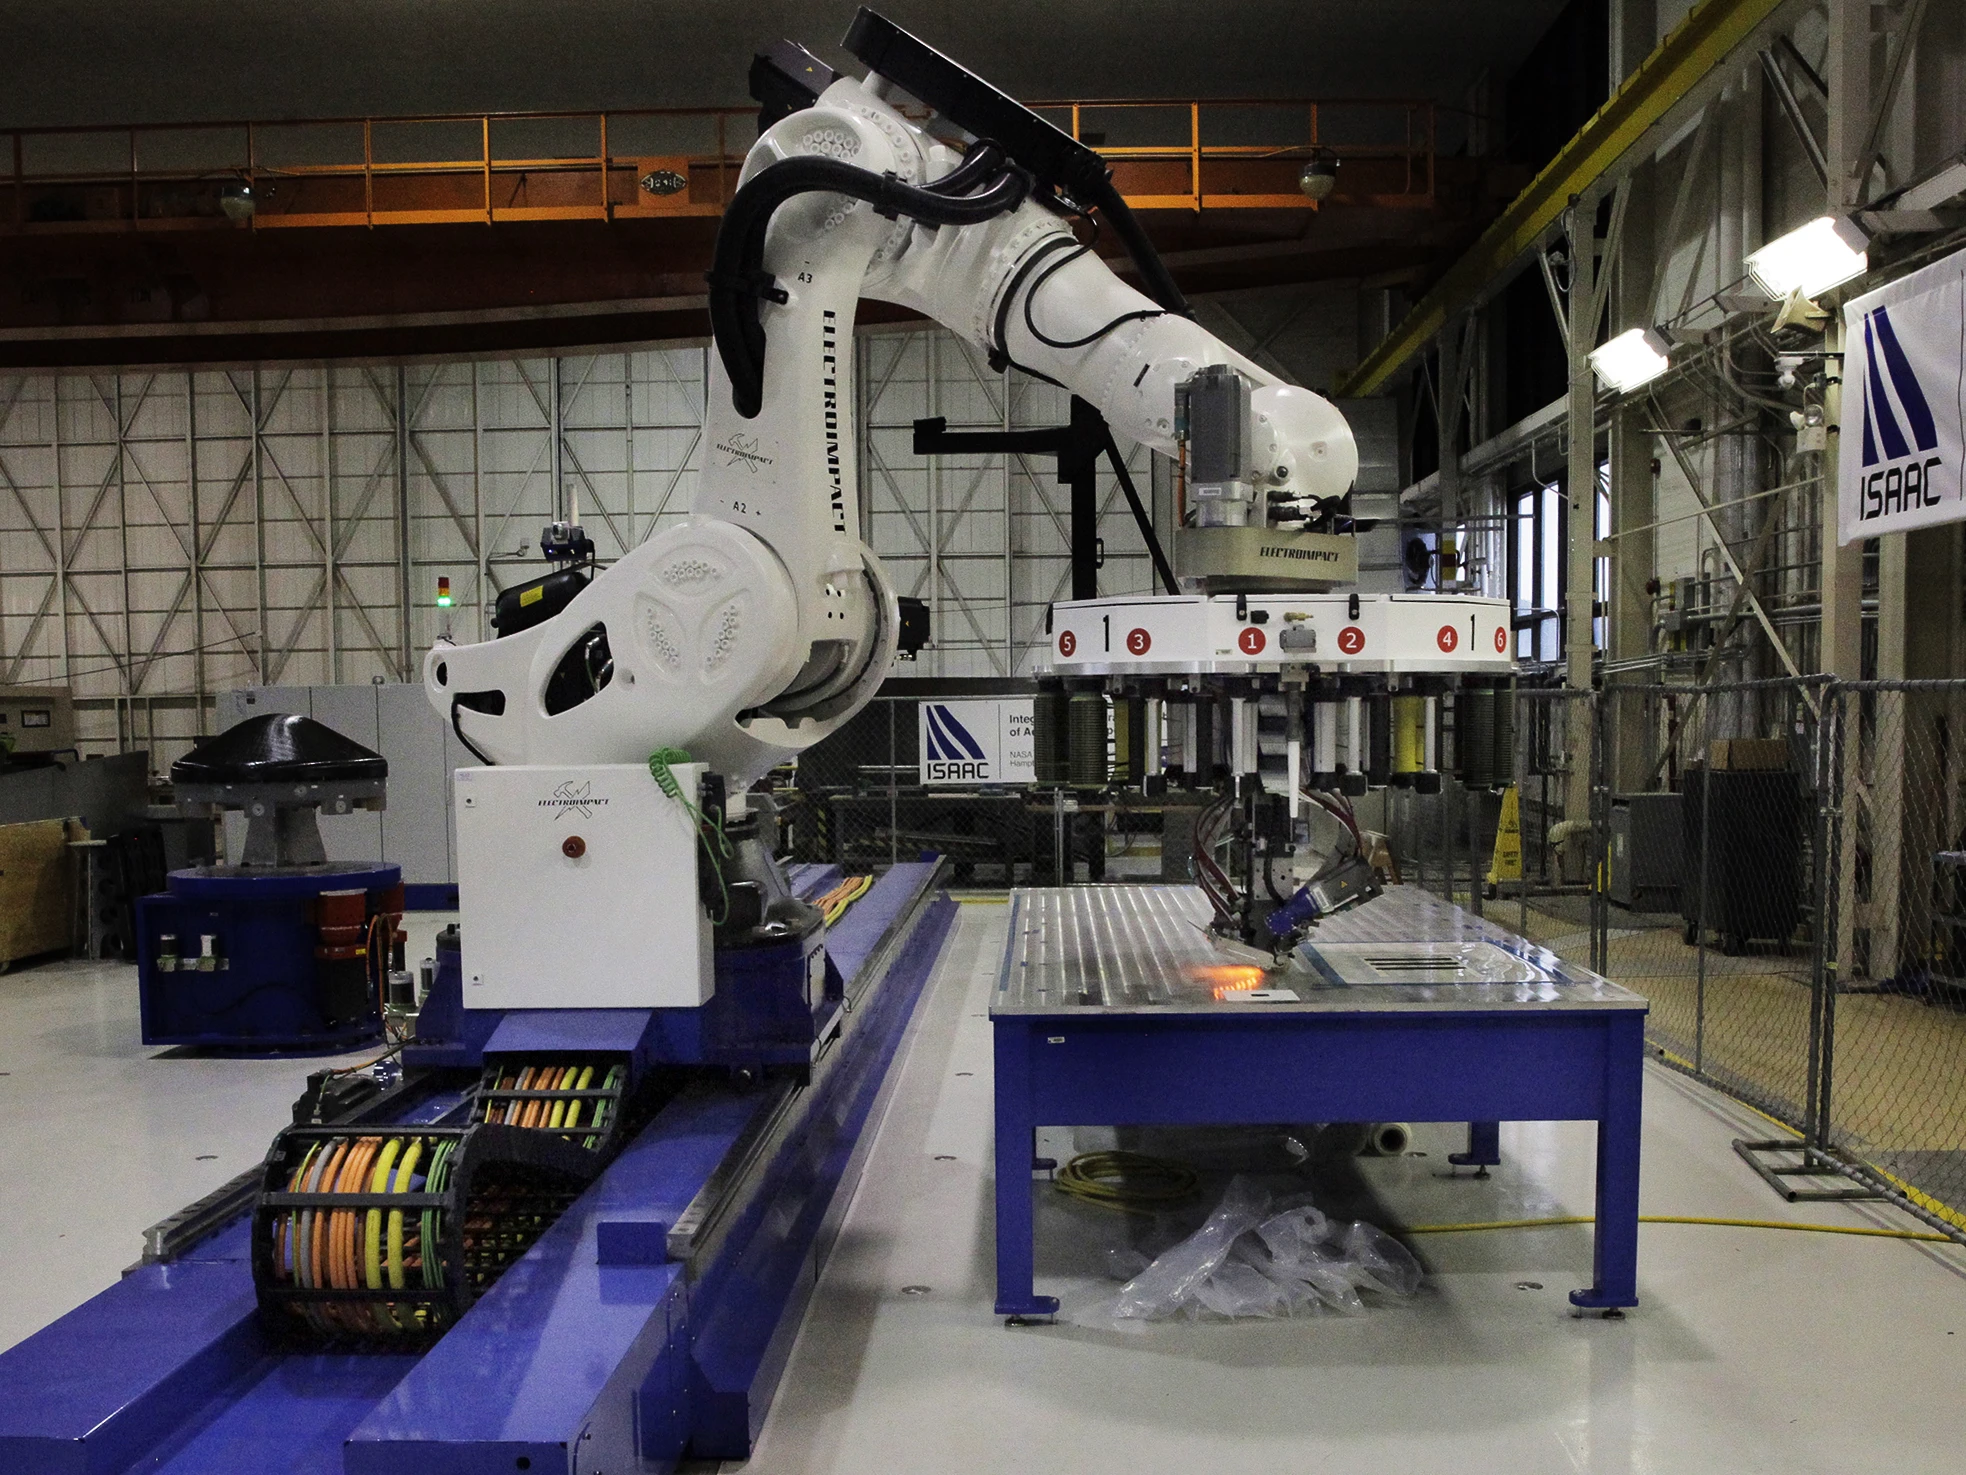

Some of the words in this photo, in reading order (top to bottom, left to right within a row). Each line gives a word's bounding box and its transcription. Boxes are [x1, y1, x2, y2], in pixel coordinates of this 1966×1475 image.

[796, 271, 813, 284] A3
[822, 310, 847, 537] ELECTROIMPACT
[716, 443, 773, 466] ELECTROIMPACT
[1859, 456, 1943, 521] ISAAC
[732, 500, 747, 514] A2
[1259, 546, 1340, 562] ELECTROIMPACT
[1102, 614, 1110, 652] 1
[1246, 633, 1257, 649] 1
[1345, 632, 1358, 649] 2
[1442, 631, 1452, 647] 4
[1497, 631, 1504, 647] 6
[1063, 636, 1072, 651] 5
[1133, 633, 1144, 650] 3
[1009, 727, 1020, 737] of
[1009, 751, 1033, 759] NASA
[926, 762, 990, 780] ISAAC
[537, 798, 610, 807] ELECTROIMPACT
